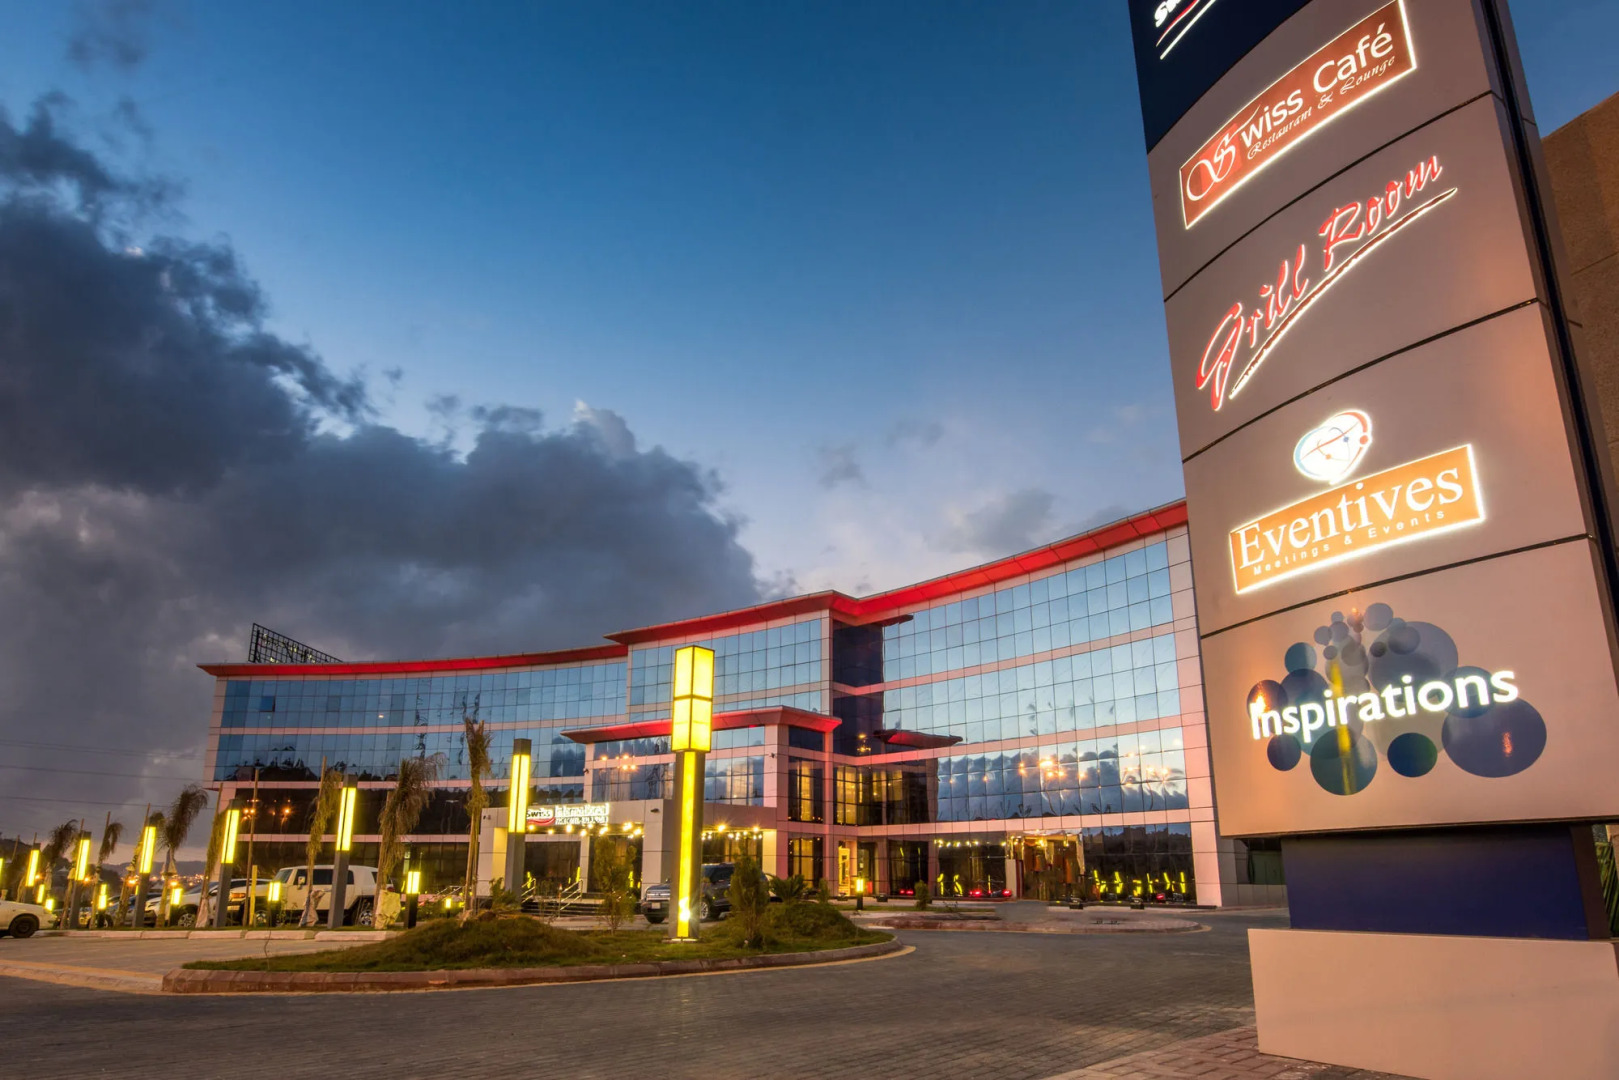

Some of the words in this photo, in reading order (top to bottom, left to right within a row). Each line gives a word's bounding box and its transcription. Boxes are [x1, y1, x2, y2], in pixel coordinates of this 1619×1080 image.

[1186, 104, 1304, 202] Swiss
[1313, 22, 1394, 93] Café
[1247, 106, 1312, 160] Restaurant
[1317, 91, 1333, 110] &
[1339, 55, 1396, 96] Lounge
[1196, 244, 1309, 411] Grill
[1318, 155, 1443, 272] Room
[1236, 467, 1464, 570] Eventives
[1253, 542, 1330, 576] Meetings
[1343, 534, 1353, 546] &
[1367, 509, 1445, 539] Events
[1249, 669, 1520, 743] Inspirations
